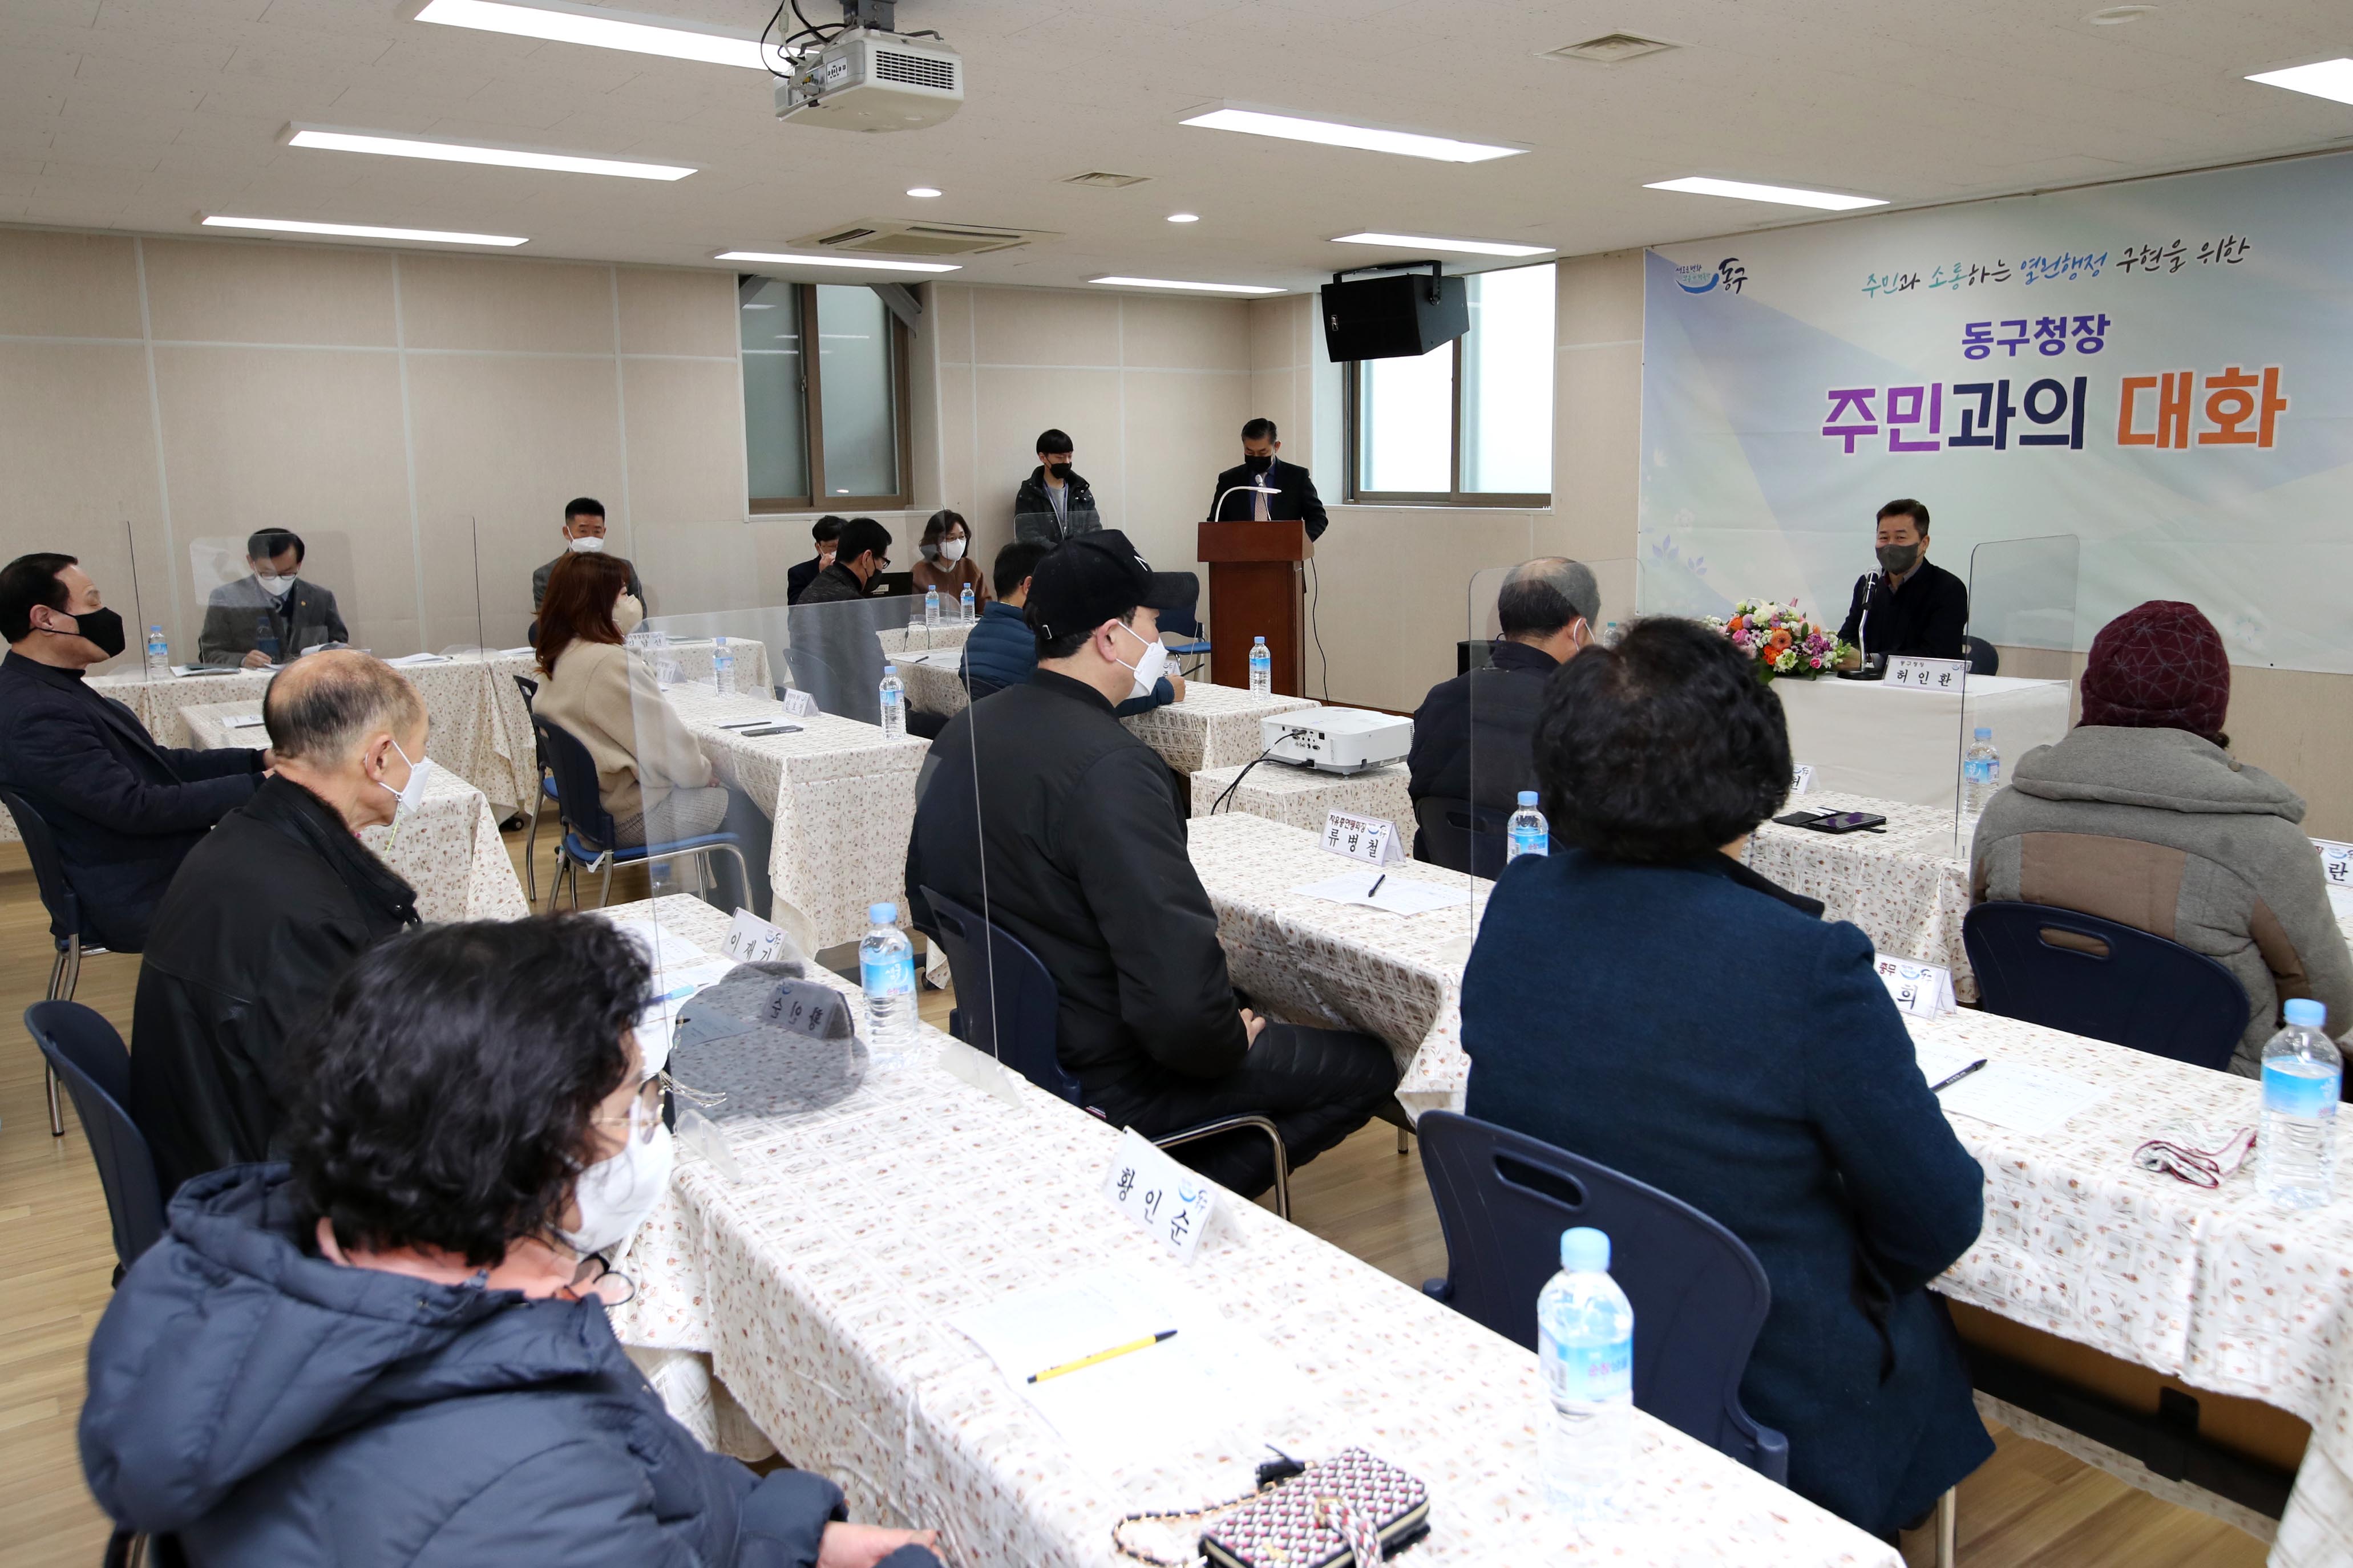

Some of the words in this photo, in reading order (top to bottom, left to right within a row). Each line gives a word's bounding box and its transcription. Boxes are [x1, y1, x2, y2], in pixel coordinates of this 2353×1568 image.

[1719, 258, 1748, 294] 동구
[1862, 273, 1921, 298] 주민과
[1929, 260, 2011, 290] 소통하는
[2020, 252, 2108, 285] 열린행정
[2116, 239, 2187, 273] 구현을
[2197, 234, 2250, 264] 위한
[1962, 314, 2111, 360] 동구청장
[1822, 376, 2087, 453] 주민과의
[2117, 367, 2287, 449] 대화
[2328, 862, 2349, 882] 란
